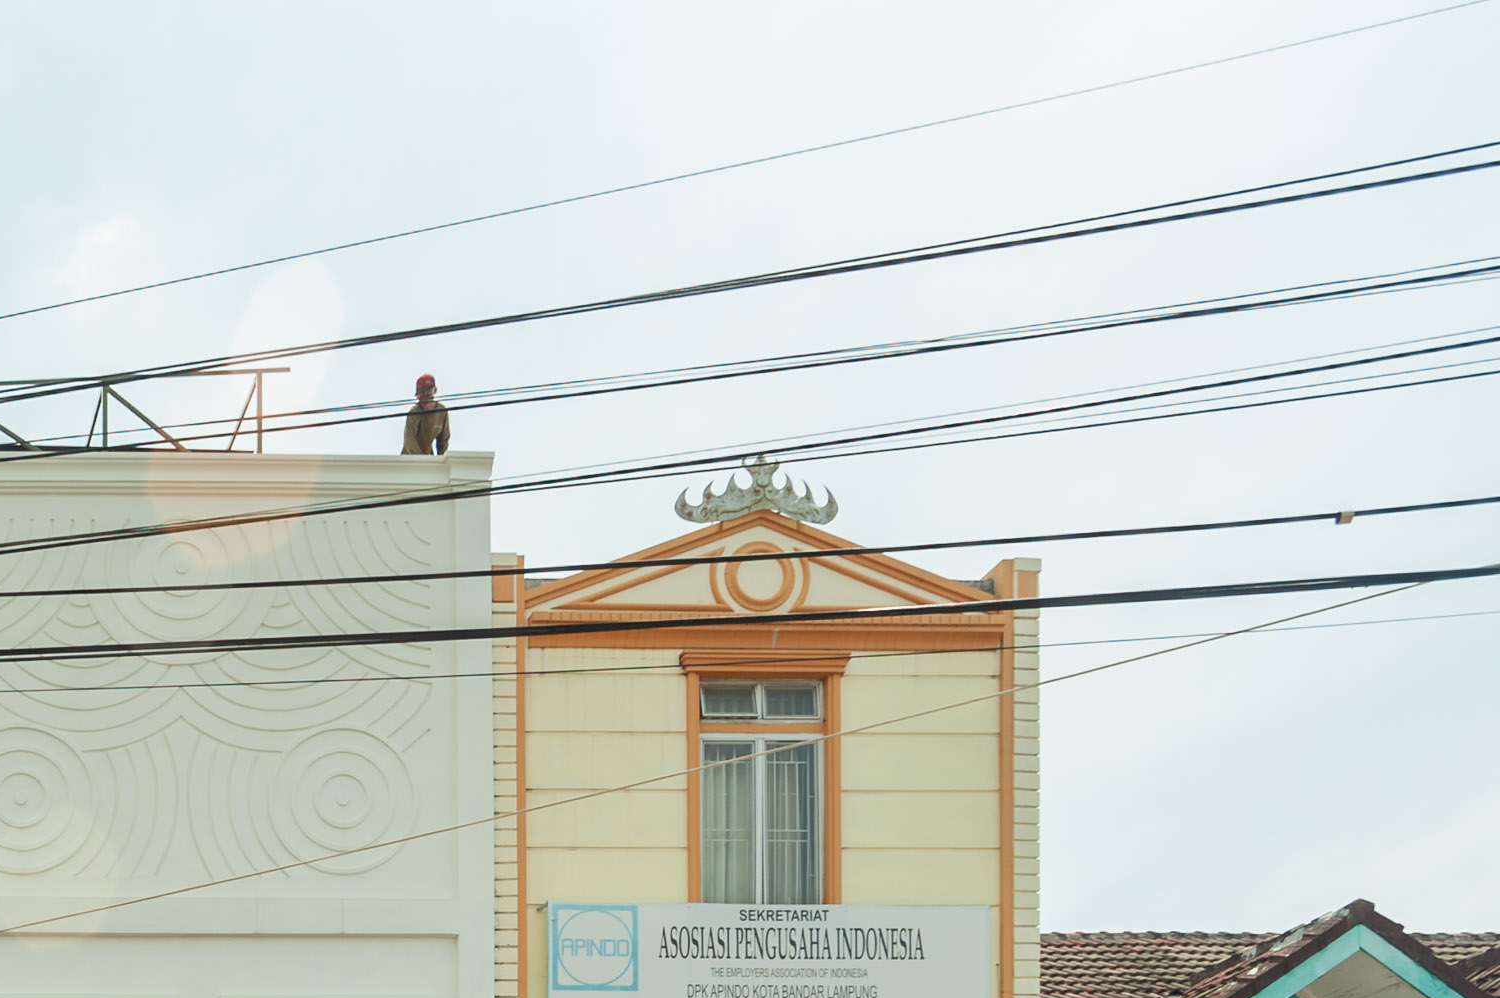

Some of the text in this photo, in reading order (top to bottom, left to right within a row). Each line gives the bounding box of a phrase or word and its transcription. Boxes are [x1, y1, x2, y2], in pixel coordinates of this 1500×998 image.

[739, 909, 830, 922] SEKRETARIAT
[561, 938, 630, 957] APINDO
[658, 926, 925, 960] ASOSIASI PENGUSAHA INDONESIA
[710, 967, 868, 978] THE EMPLOYERS ASSOCIATION OF INDONESIA
[687, 984, 709, 998] DPK
[710, 984, 750, 998] APINDO
[752, 985, 780, 998] KOTA
